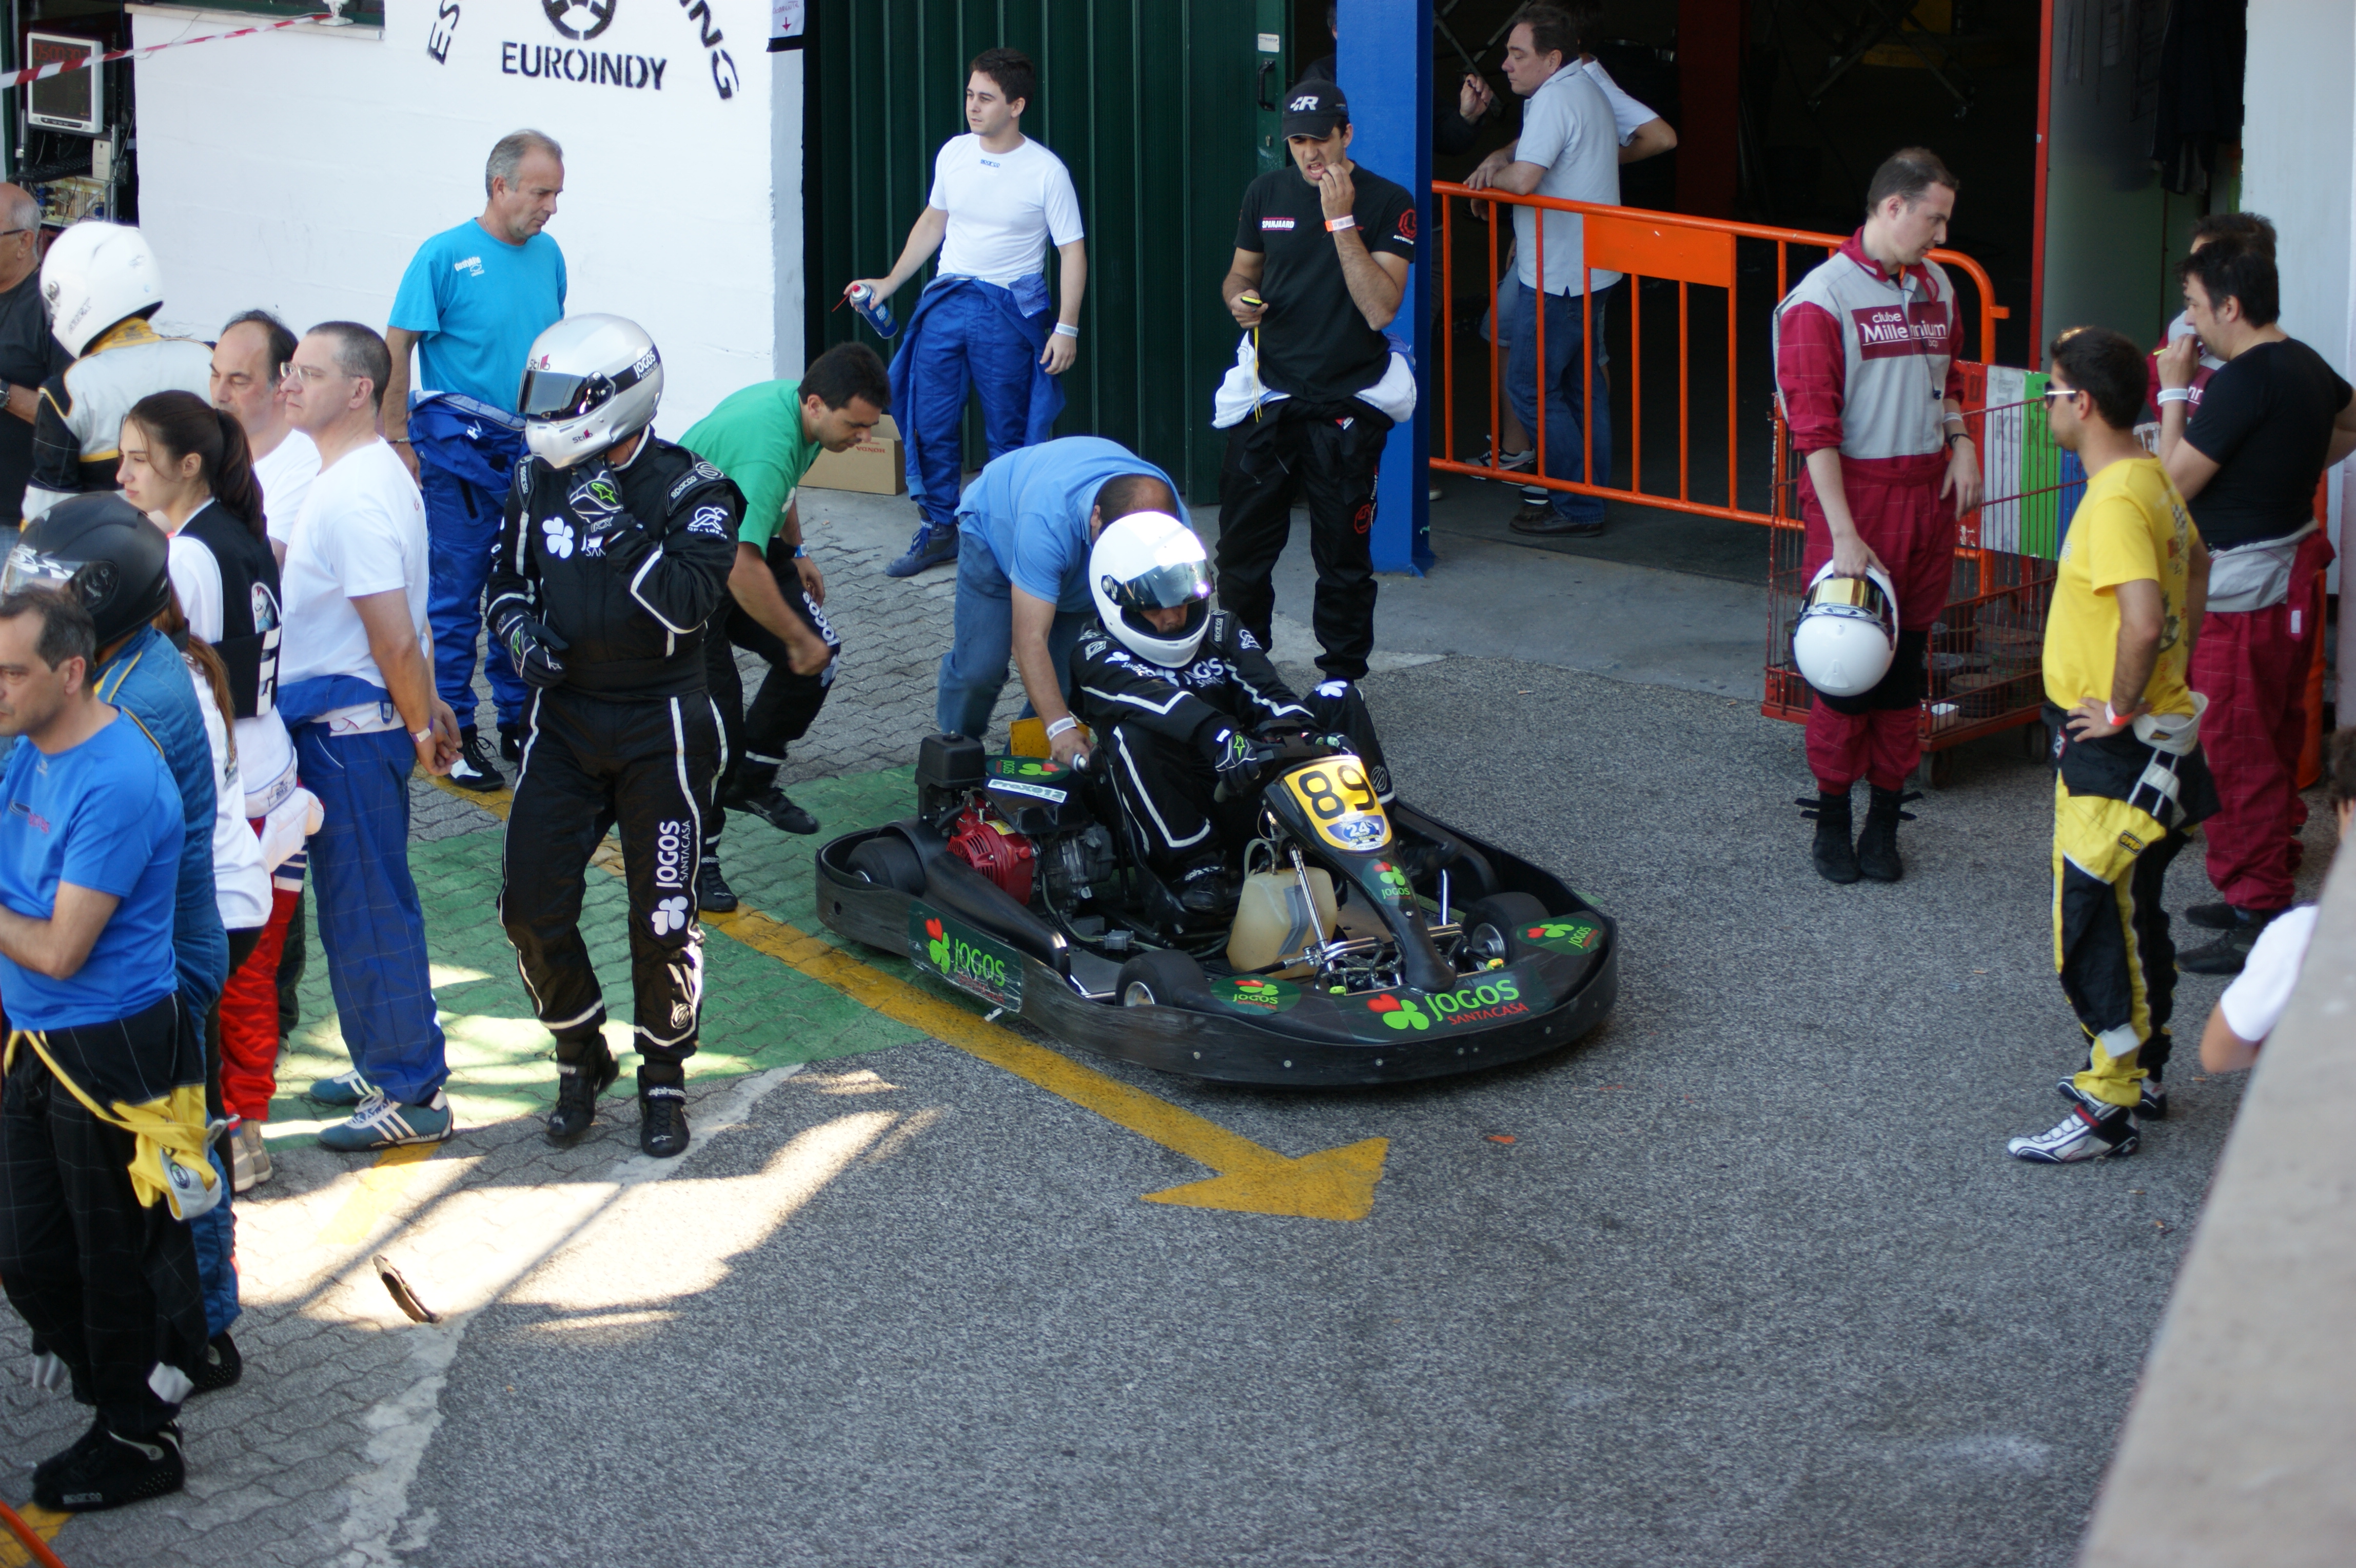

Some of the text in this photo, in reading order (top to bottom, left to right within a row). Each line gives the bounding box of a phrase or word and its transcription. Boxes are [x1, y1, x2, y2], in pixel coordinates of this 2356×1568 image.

[501, 41, 667, 90] EUROINDY
[1262, 220, 1294, 229] SPANJAARD
[1873, 311, 1902, 323] clube
[1928, 339, 1939, 349] bcp
[633, 350, 657, 379] JOGOS
[572, 429, 594, 444] Stilo
[670, 475, 698, 499] sparco
[802, 591, 841, 647] JOGOS
[1298, 765, 1376, 820] 89
[1346, 821, 1371, 837] 24
[679, 820, 691, 881] SANTACASA
[2120, 834, 2142, 850] OMP
[656, 820, 683, 889] JOGOS
[1381, 887, 1411, 899] JOGOS
[1568, 926, 1592, 949] JOGOS
[953, 938, 1005, 987] JOGOS
[1232, 994, 1279, 1005] JOGOS
[1424, 979, 1524, 1022] JOGOS
[1447, 1002, 1529, 1026] SANTACASA
